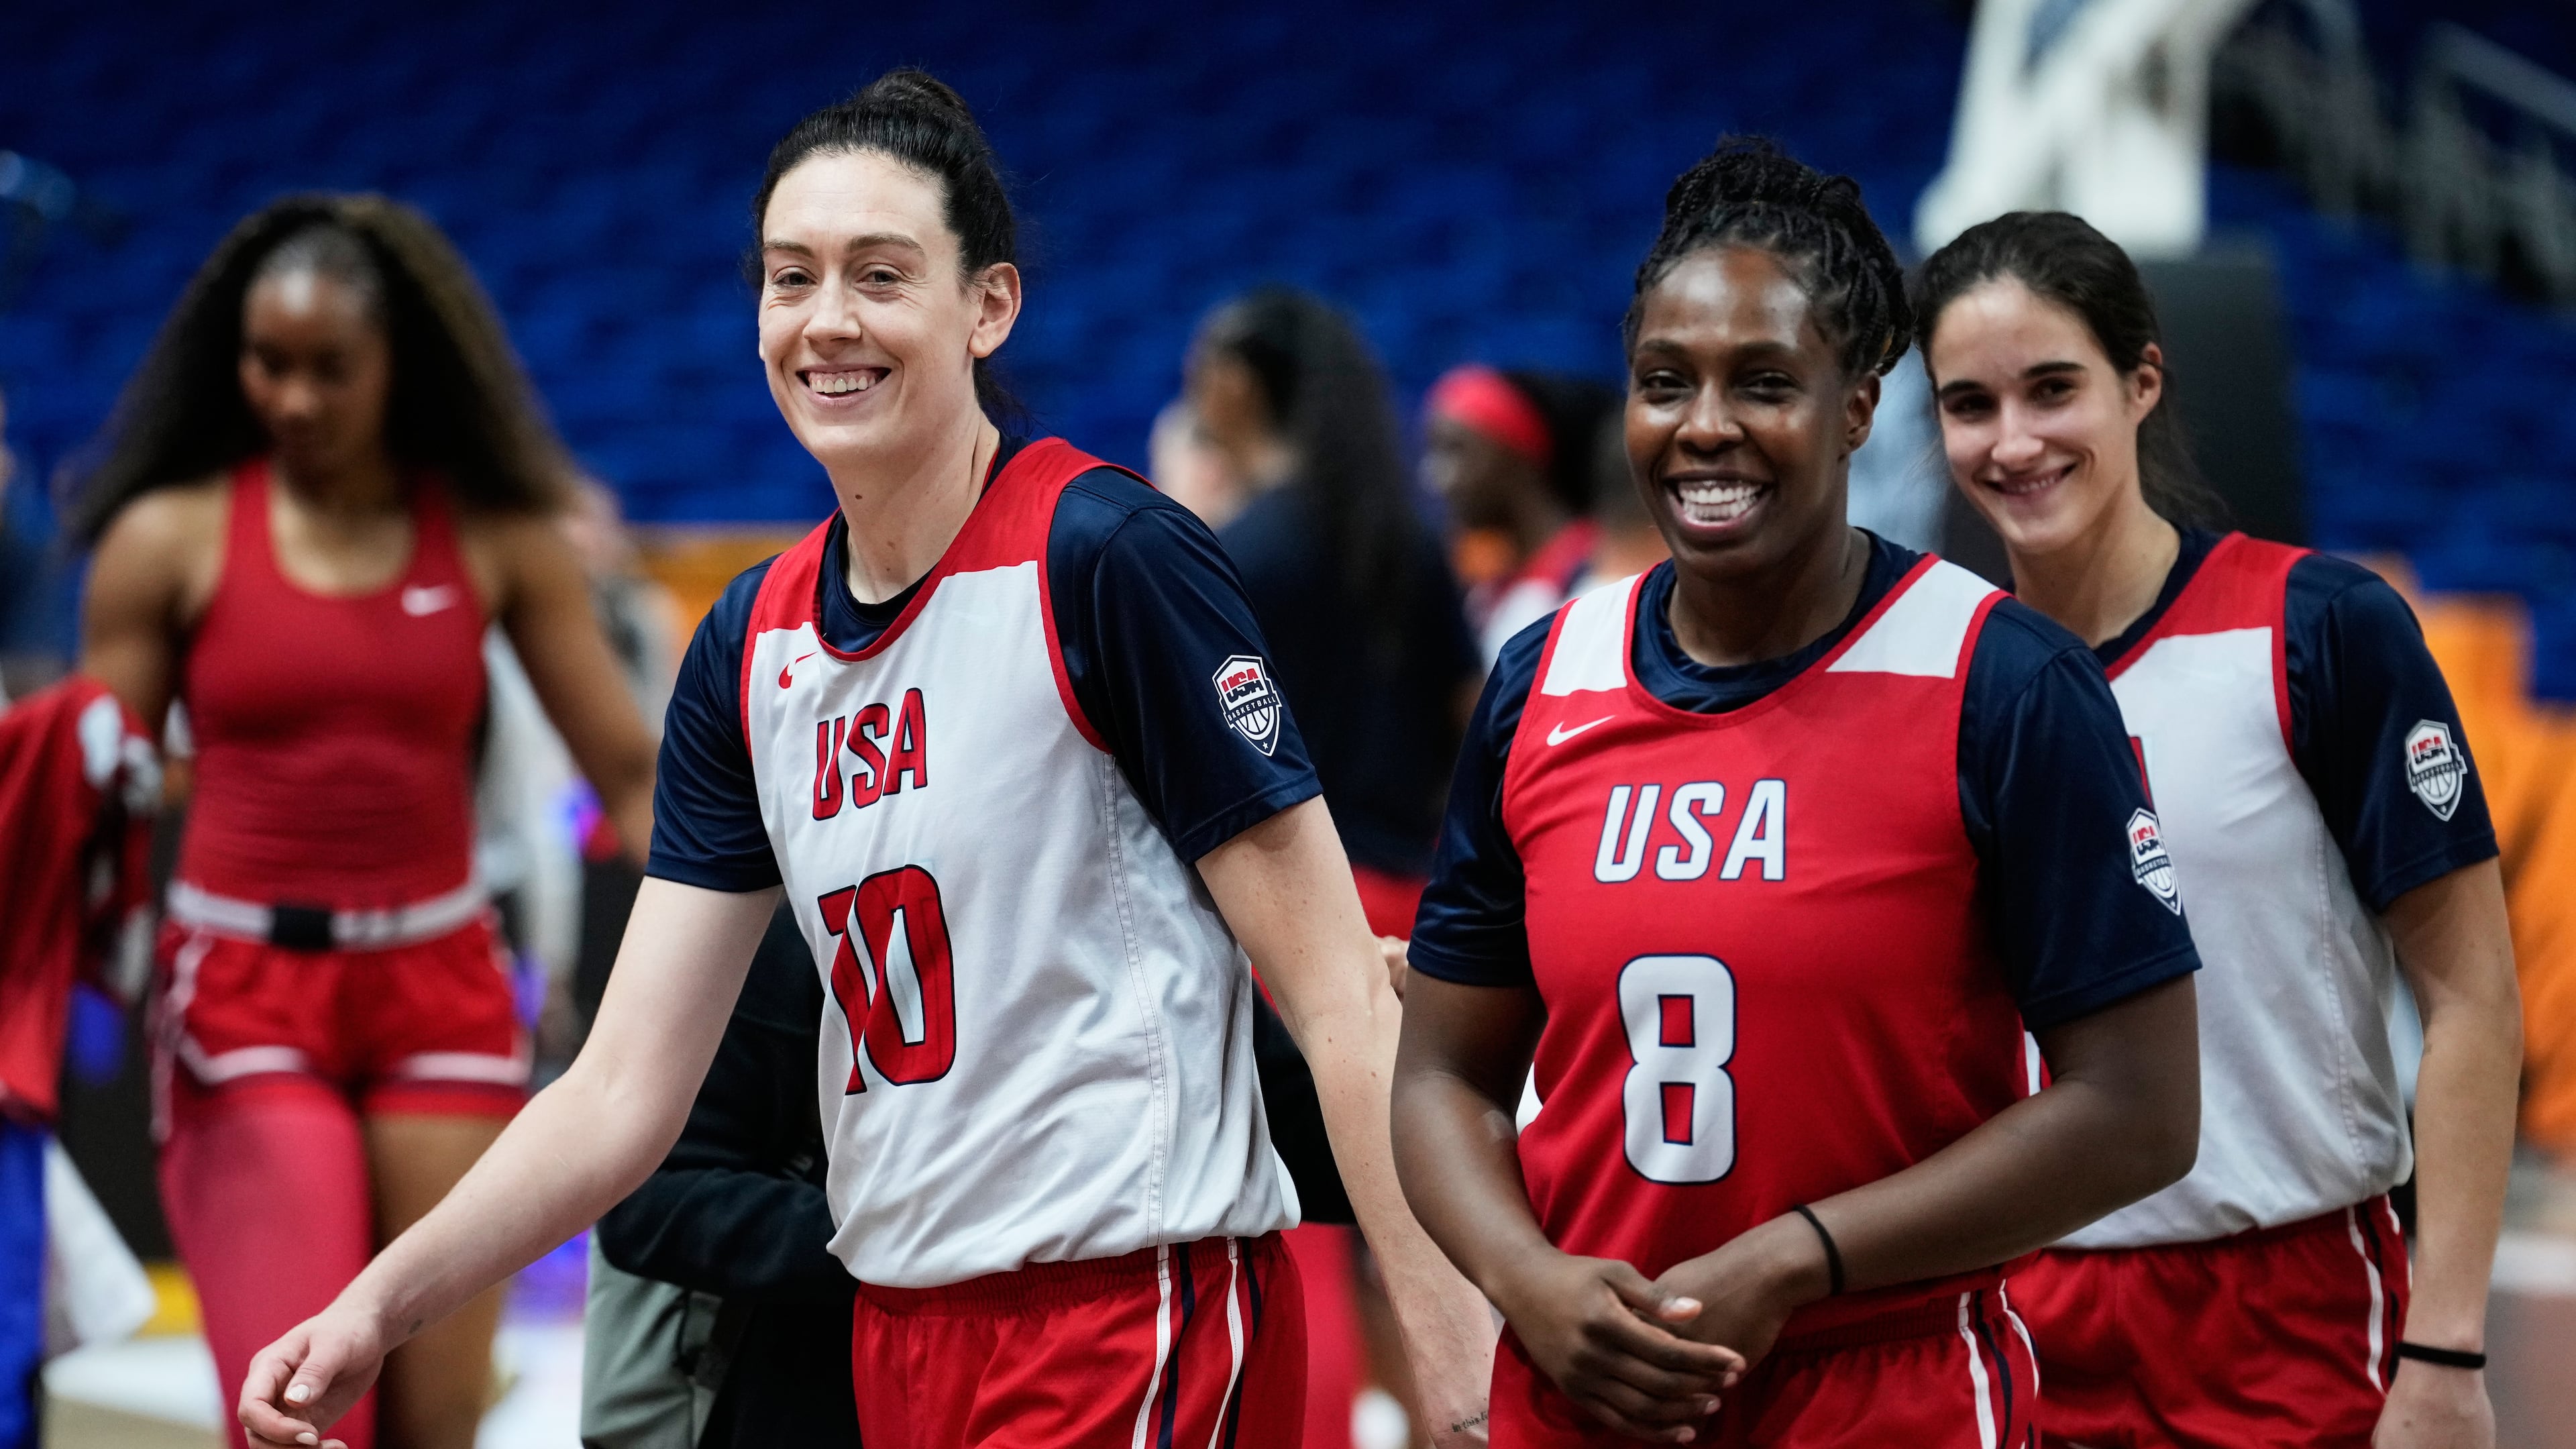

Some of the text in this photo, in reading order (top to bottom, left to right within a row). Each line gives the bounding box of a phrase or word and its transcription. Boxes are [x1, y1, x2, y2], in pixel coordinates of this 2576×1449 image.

[1221, 667, 1265, 704] USA
[1227, 696, 1276, 721] BASKETBALL
[812, 687, 928, 821] USA
[2412, 736, 2447, 765] USA
[1594, 778, 1786, 883] USA
[2132, 825, 2163, 857] USA
[818, 864, 957, 1095] 10
[1617, 953, 1737, 1186] 8
